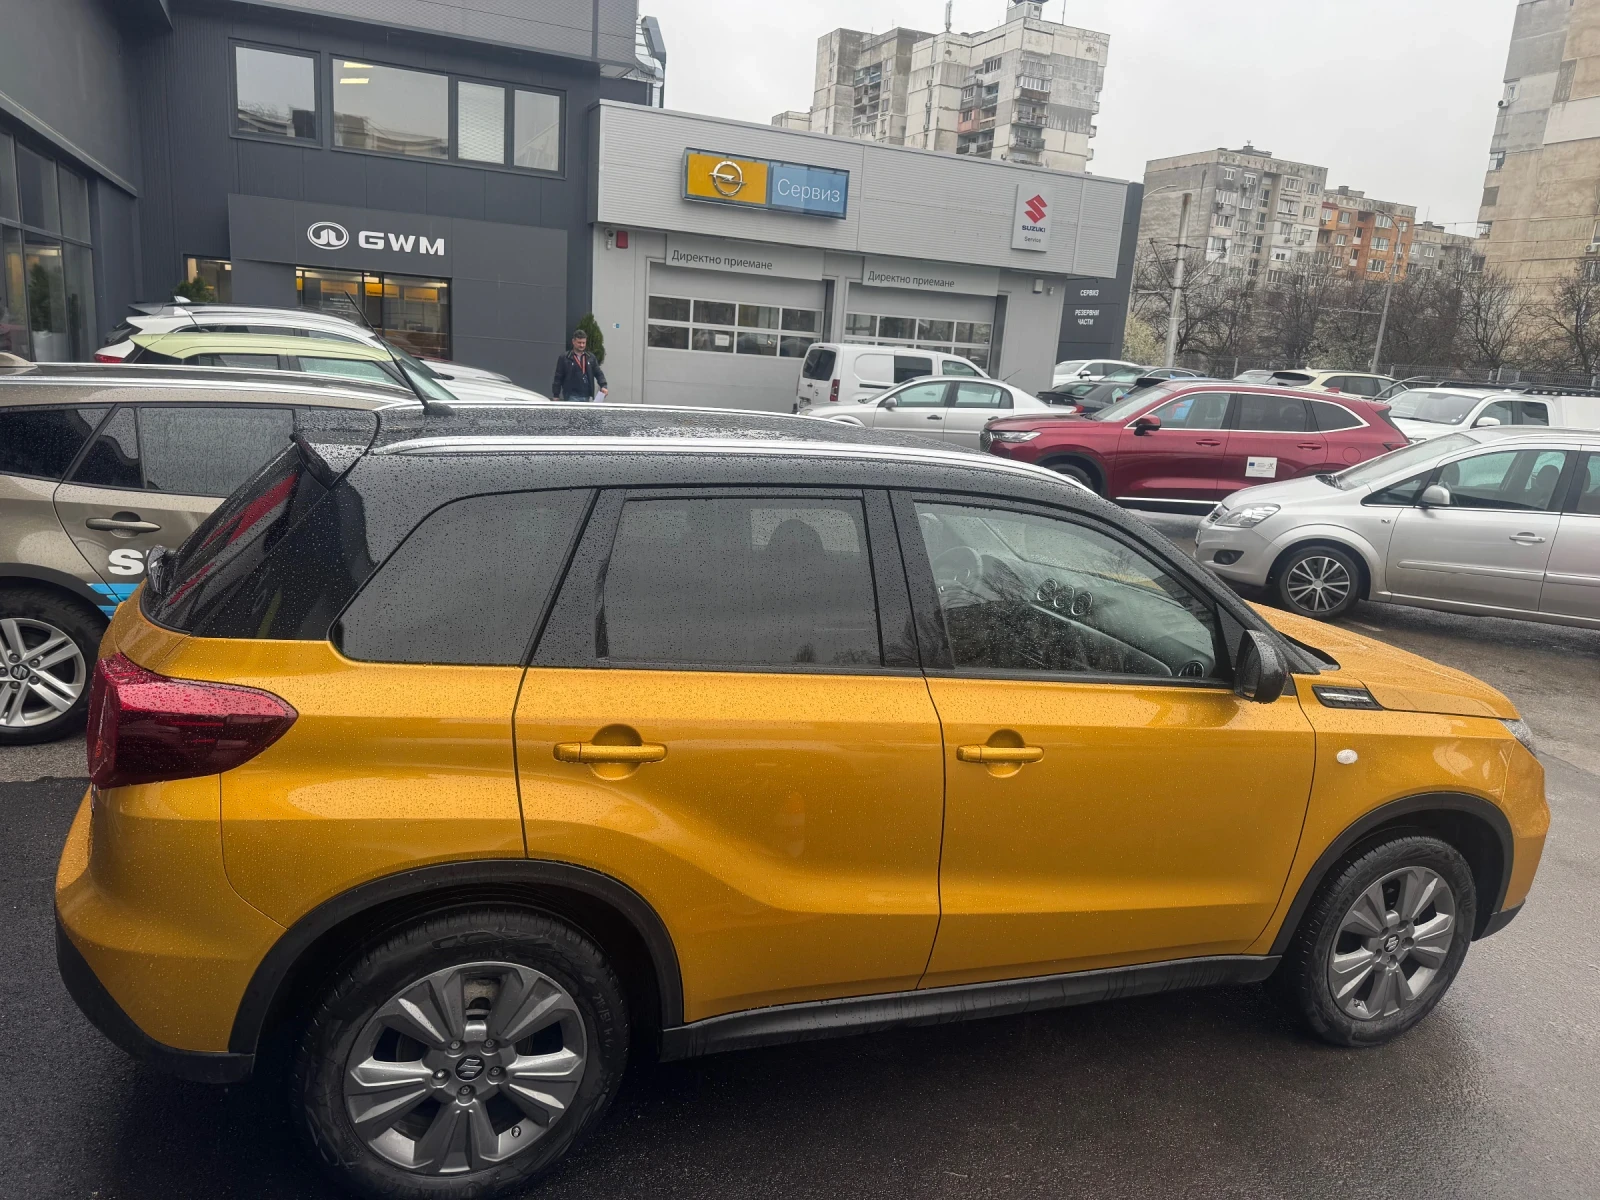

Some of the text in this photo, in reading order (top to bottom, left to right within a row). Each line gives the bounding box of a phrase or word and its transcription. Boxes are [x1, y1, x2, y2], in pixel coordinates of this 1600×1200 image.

[777, 178, 840, 203] Сервиз
[1021, 224, 1046, 233] SUZUKI
[1023, 235, 1042, 243] Service
[358, 230, 445, 256] GWM
[671, 249, 773, 270] Директно приемане
[867, 270, 955, 288] Директно приемане
[107, 548, 150, 576] S
